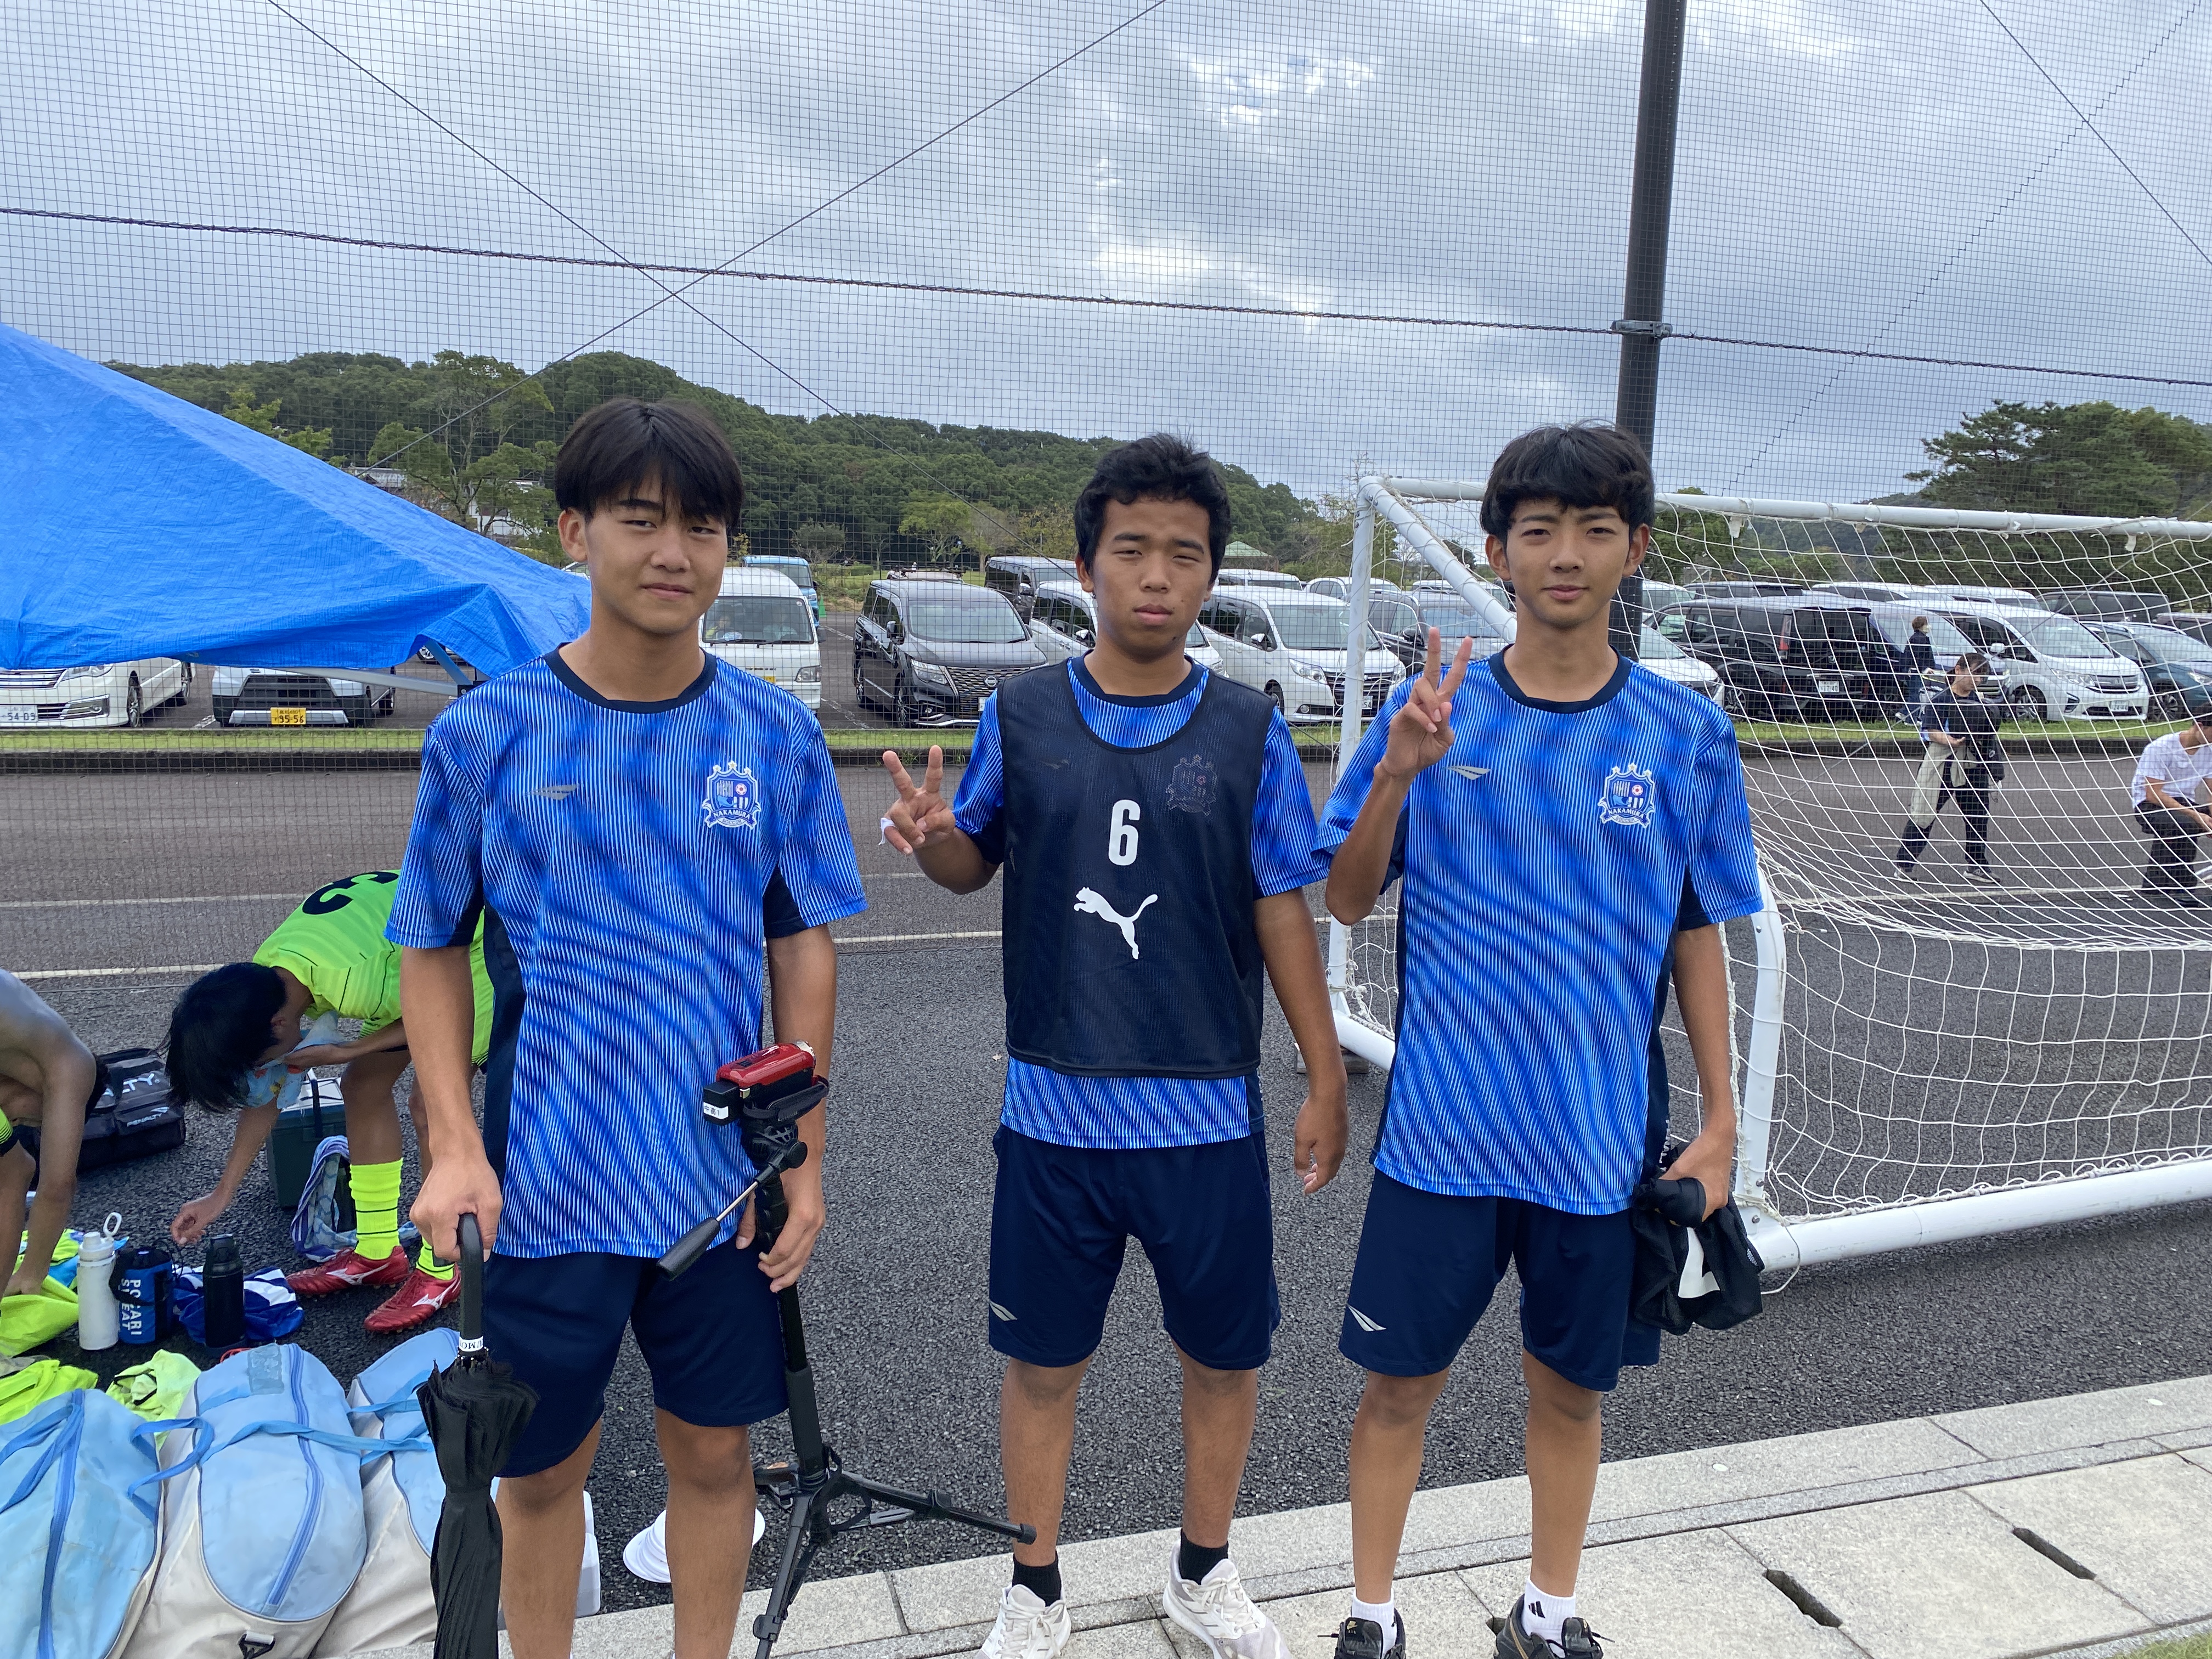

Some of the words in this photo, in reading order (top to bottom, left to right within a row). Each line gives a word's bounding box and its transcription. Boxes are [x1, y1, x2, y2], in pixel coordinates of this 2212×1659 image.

[279, 715, 304, 723] 95-56
[713, 809, 750, 820] NAKAMURA
[1608, 808, 1644, 819] NAKAMURA
[1108, 799, 1141, 866] 6
[127, 1113, 162, 1127] PENALTY
